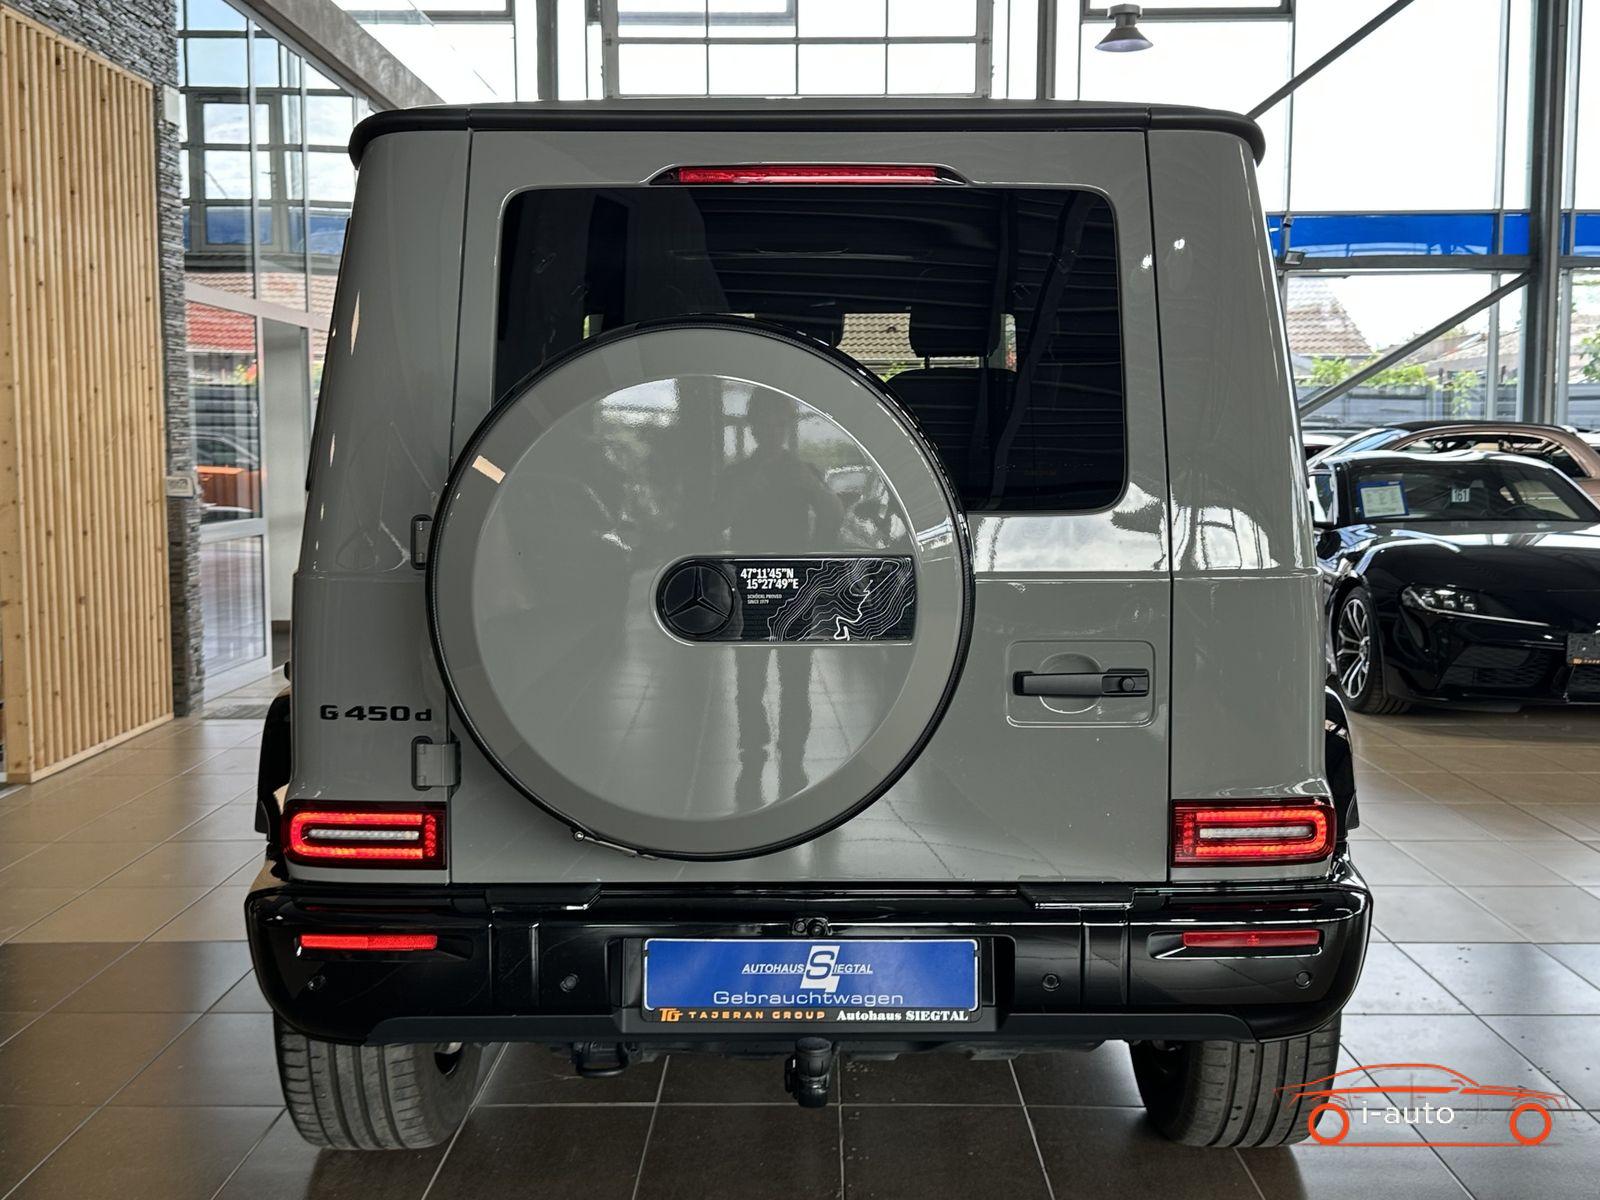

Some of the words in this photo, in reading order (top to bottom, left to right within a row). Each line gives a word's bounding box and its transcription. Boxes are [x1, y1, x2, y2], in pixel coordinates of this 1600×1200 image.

[320, 705, 338, 720] G
[345, 706, 410, 721] 450
[415, 708, 432, 721] d
[742, 964, 804, 974] AUTOHAUS
[713, 990, 903, 1008] Gebrauchtwagen
[688, 1011, 764, 1020] TAJERAN
[772, 1011, 825, 1020] GROUP
[836, 1009, 903, 1021] Autohaus
[905, 1010, 968, 1021] SIEGTAL
